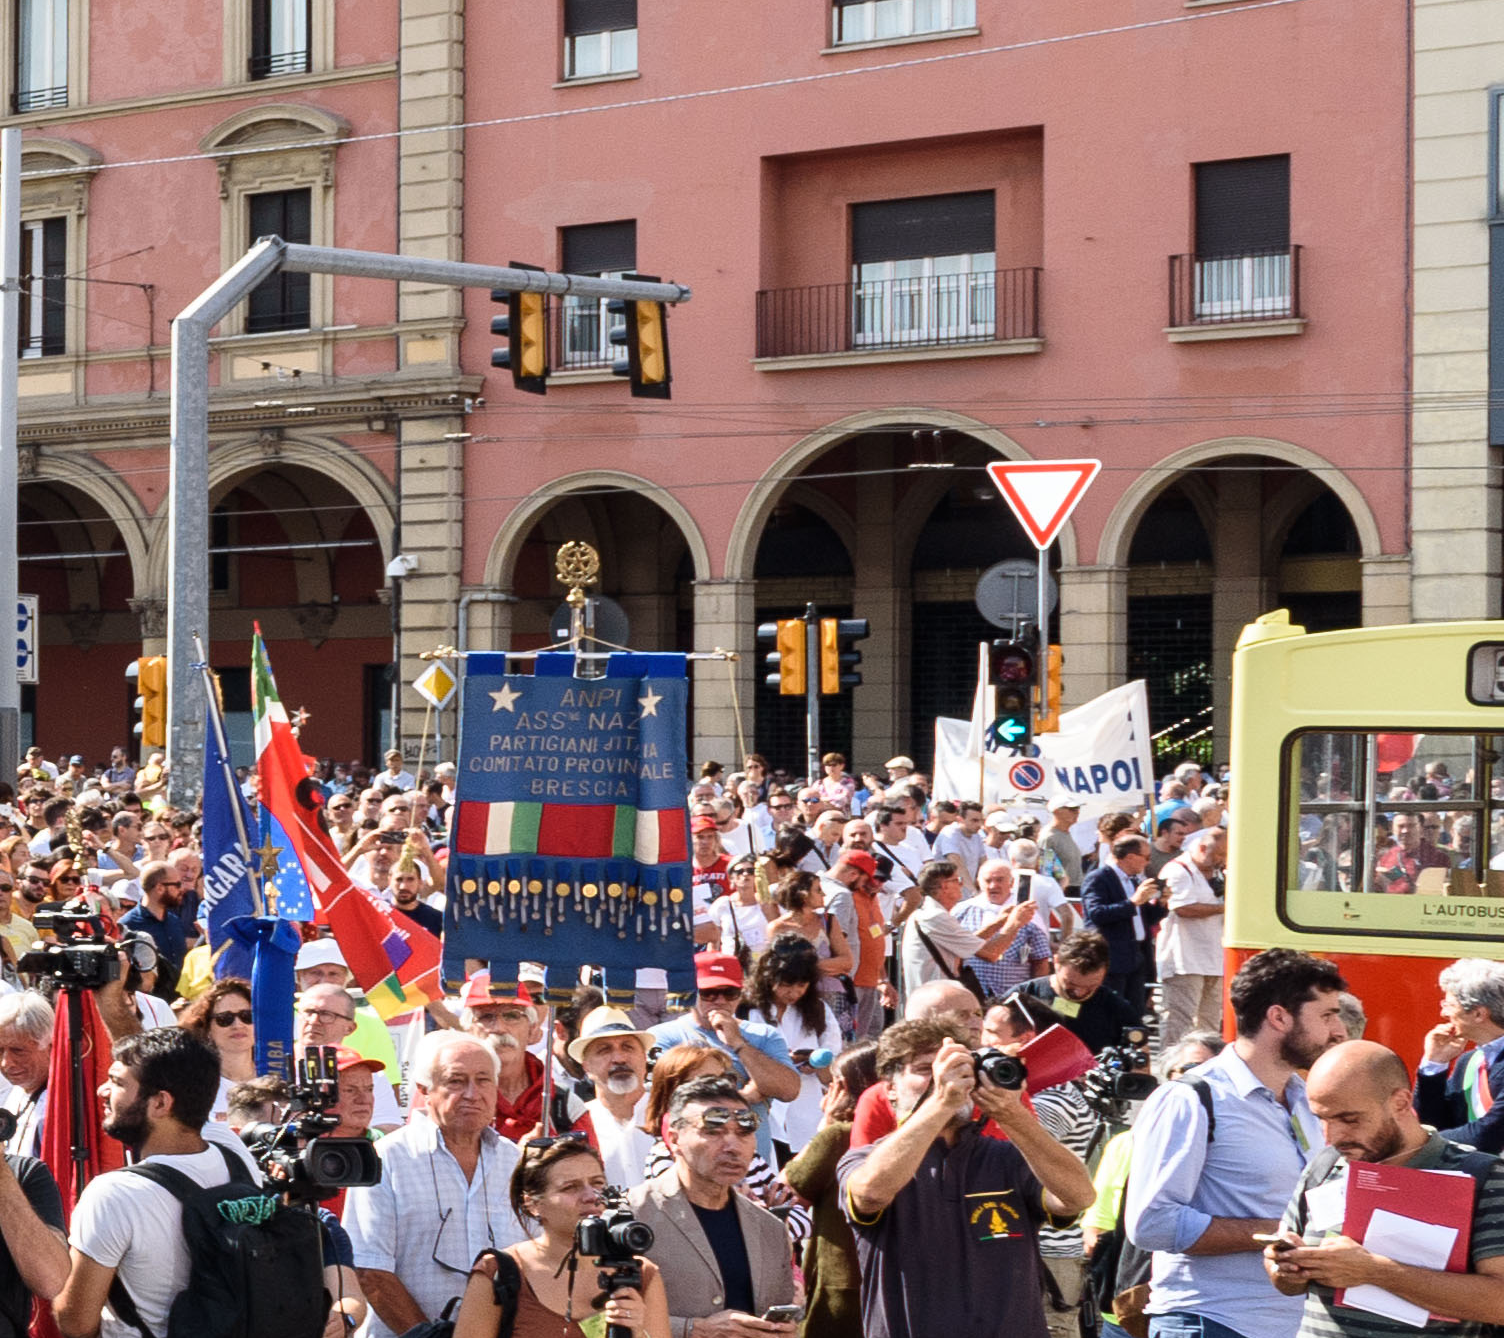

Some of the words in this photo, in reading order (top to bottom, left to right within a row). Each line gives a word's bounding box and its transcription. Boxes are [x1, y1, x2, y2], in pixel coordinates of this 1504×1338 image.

[560, 688, 622, 708] ANPI
[490, 735, 598, 753] PARTIGIANI
[469, 757, 559, 773] COMITATO
